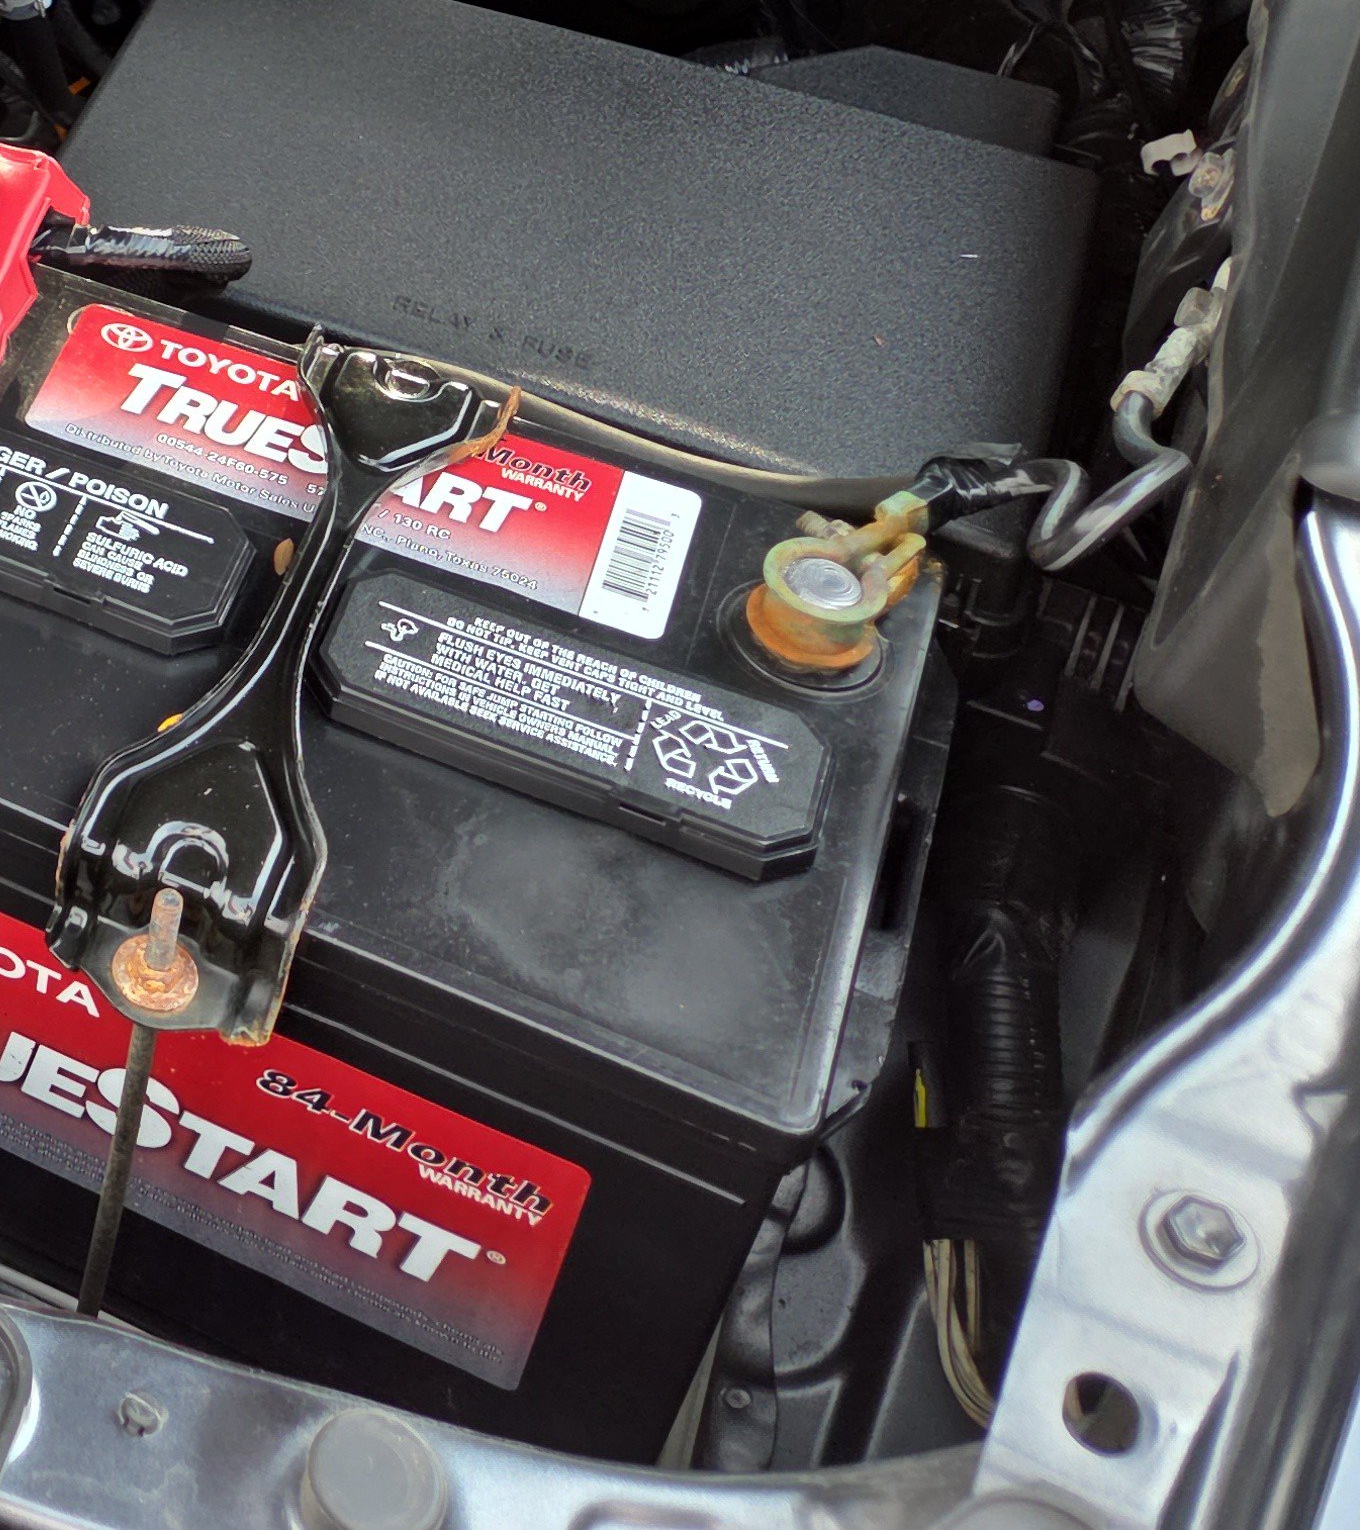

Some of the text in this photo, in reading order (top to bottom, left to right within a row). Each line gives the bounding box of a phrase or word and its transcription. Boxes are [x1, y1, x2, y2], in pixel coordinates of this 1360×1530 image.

[392, 295, 478, 331] RELAY
[522, 334, 591, 369] FUSE
[159, 339, 300, 402] TOYOTA
[65, 422, 142, 457] Distributed
[144, 449, 162, 464] by
[161, 454, 210, 480] Toyota
[212, 472, 257, 498] Motor
[259, 488, 299, 510] Sales
[445, 549, 489, 574] Texas
[491, 565, 538, 591] 75024
[69, 471, 169, 519] POISON
[500, 468, 585, 502] WARRANTY
[14, 505, 37, 520] NO
[394, 513, 423, 531] 130
[73, 557, 150, 594] SEVERE BURNS
[77, 549, 155, 585] BLINDNESS OR
[81, 541, 144, 572] CAN CAUSE
[86, 532, 189, 578] SULFURIC ACID
[436, 643, 472, 665] WITH
[530, 673, 561, 695] GET
[437, 631, 484, 658] FLUSH
[485, 644, 522, 670] EYES
[446, 616, 464, 630] DO
[465, 623, 492, 642] NOT
[518, 641, 549, 659] KEEP
[551, 651, 582, 670] VENT
[583, 666, 616, 684] CAPS
[618, 677, 656, 699] TIGHT
[656, 691, 685, 708] AND
[685, 701, 725, 722] LEVEL
[473, 616, 702, 703] KEEP OUT OF THE REACH OF CHILDREN
[374, 668, 386, 680] IF
[386, 674, 410, 690] NOT
[410, 684, 469, 715] AVAILABLE
[468, 704, 499, 723] SEEK
[498, 715, 545, 740] SERVICE
[379, 661, 457, 699] INSTRUCTIONS
[457, 689, 472, 703] IN
[472, 694, 518, 719] VEHICLE
[518, 710, 567, 737] OWNERS
[383, 653, 623, 747] CAUTION: FOR SAFE JUMP STARTING FOLLOW
[430, 654, 571, 712] MEDICAL HELP FAST
[650, 709, 682, 729] LEAD
[746, 739, 780, 783] RETURN
[664, 777, 732, 810] RECYCLE
[256, 1067, 555, 1216] 84-Month
[414, 1162, 549, 1228] WARRANTY
